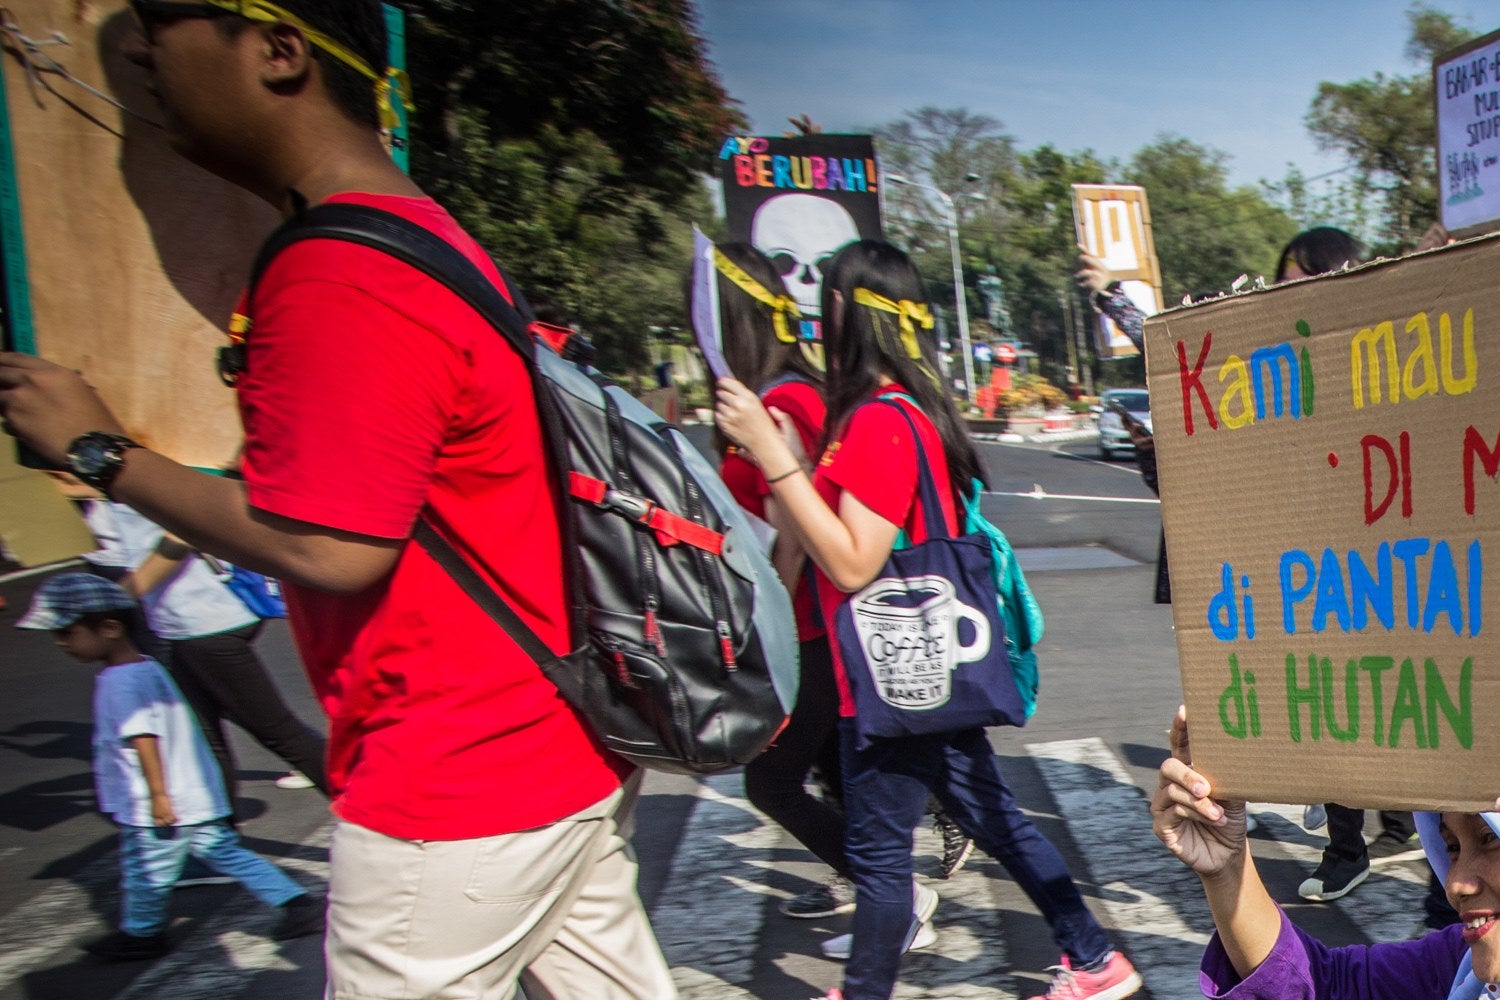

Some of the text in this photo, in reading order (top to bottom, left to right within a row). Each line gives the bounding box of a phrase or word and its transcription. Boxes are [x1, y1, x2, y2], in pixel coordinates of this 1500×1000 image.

[719, 136, 770, 161] AYO
[733, 154, 878, 193] BERUBAH!
[1176, 318, 1315, 437] Kami
[1350, 307, 1478, 409] mau
[1360, 430, 1414, 526] DI
[1207, 562, 1256, 642] di
[1279, 536, 1482, 638] PANTAI
[884, 684, 943, 701] MAKE IT
[1218, 651, 1262, 741] di
[1285, 652, 1475, 751] HUTAN
